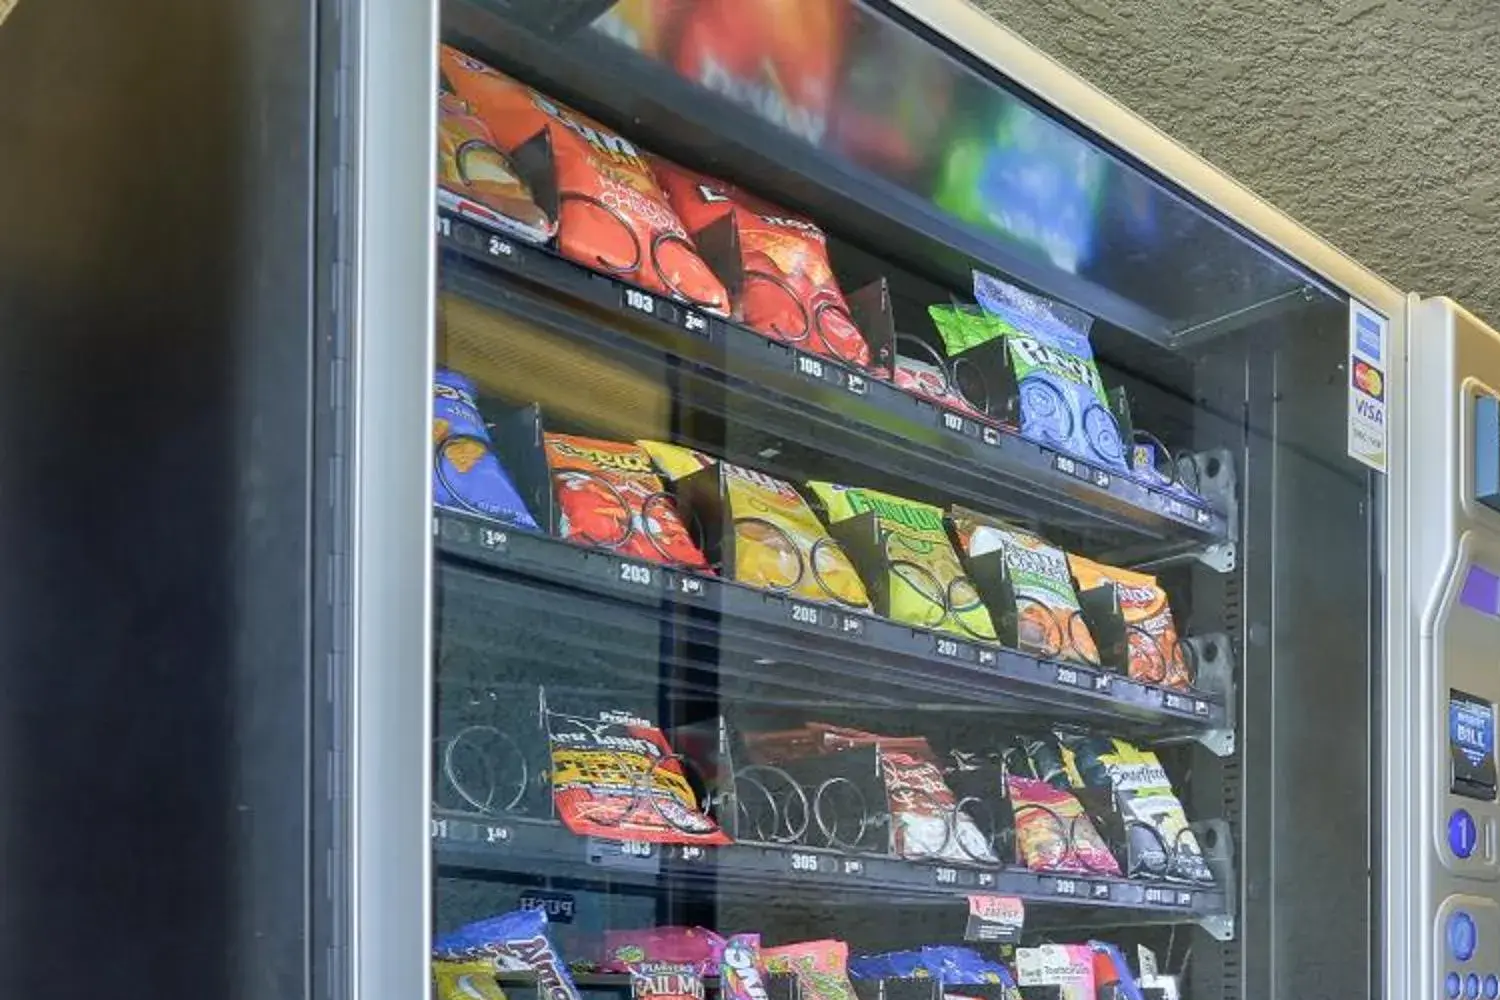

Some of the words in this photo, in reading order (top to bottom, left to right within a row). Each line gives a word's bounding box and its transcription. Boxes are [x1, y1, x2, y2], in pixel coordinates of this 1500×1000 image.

[626, 289, 654, 313] 103
[800, 357, 822, 377] 105
[1355, 398, 1384, 425] VISA
[620, 564, 650, 585] 203
[792, 605, 816, 625] 205
[792, 853, 817, 870] 305
